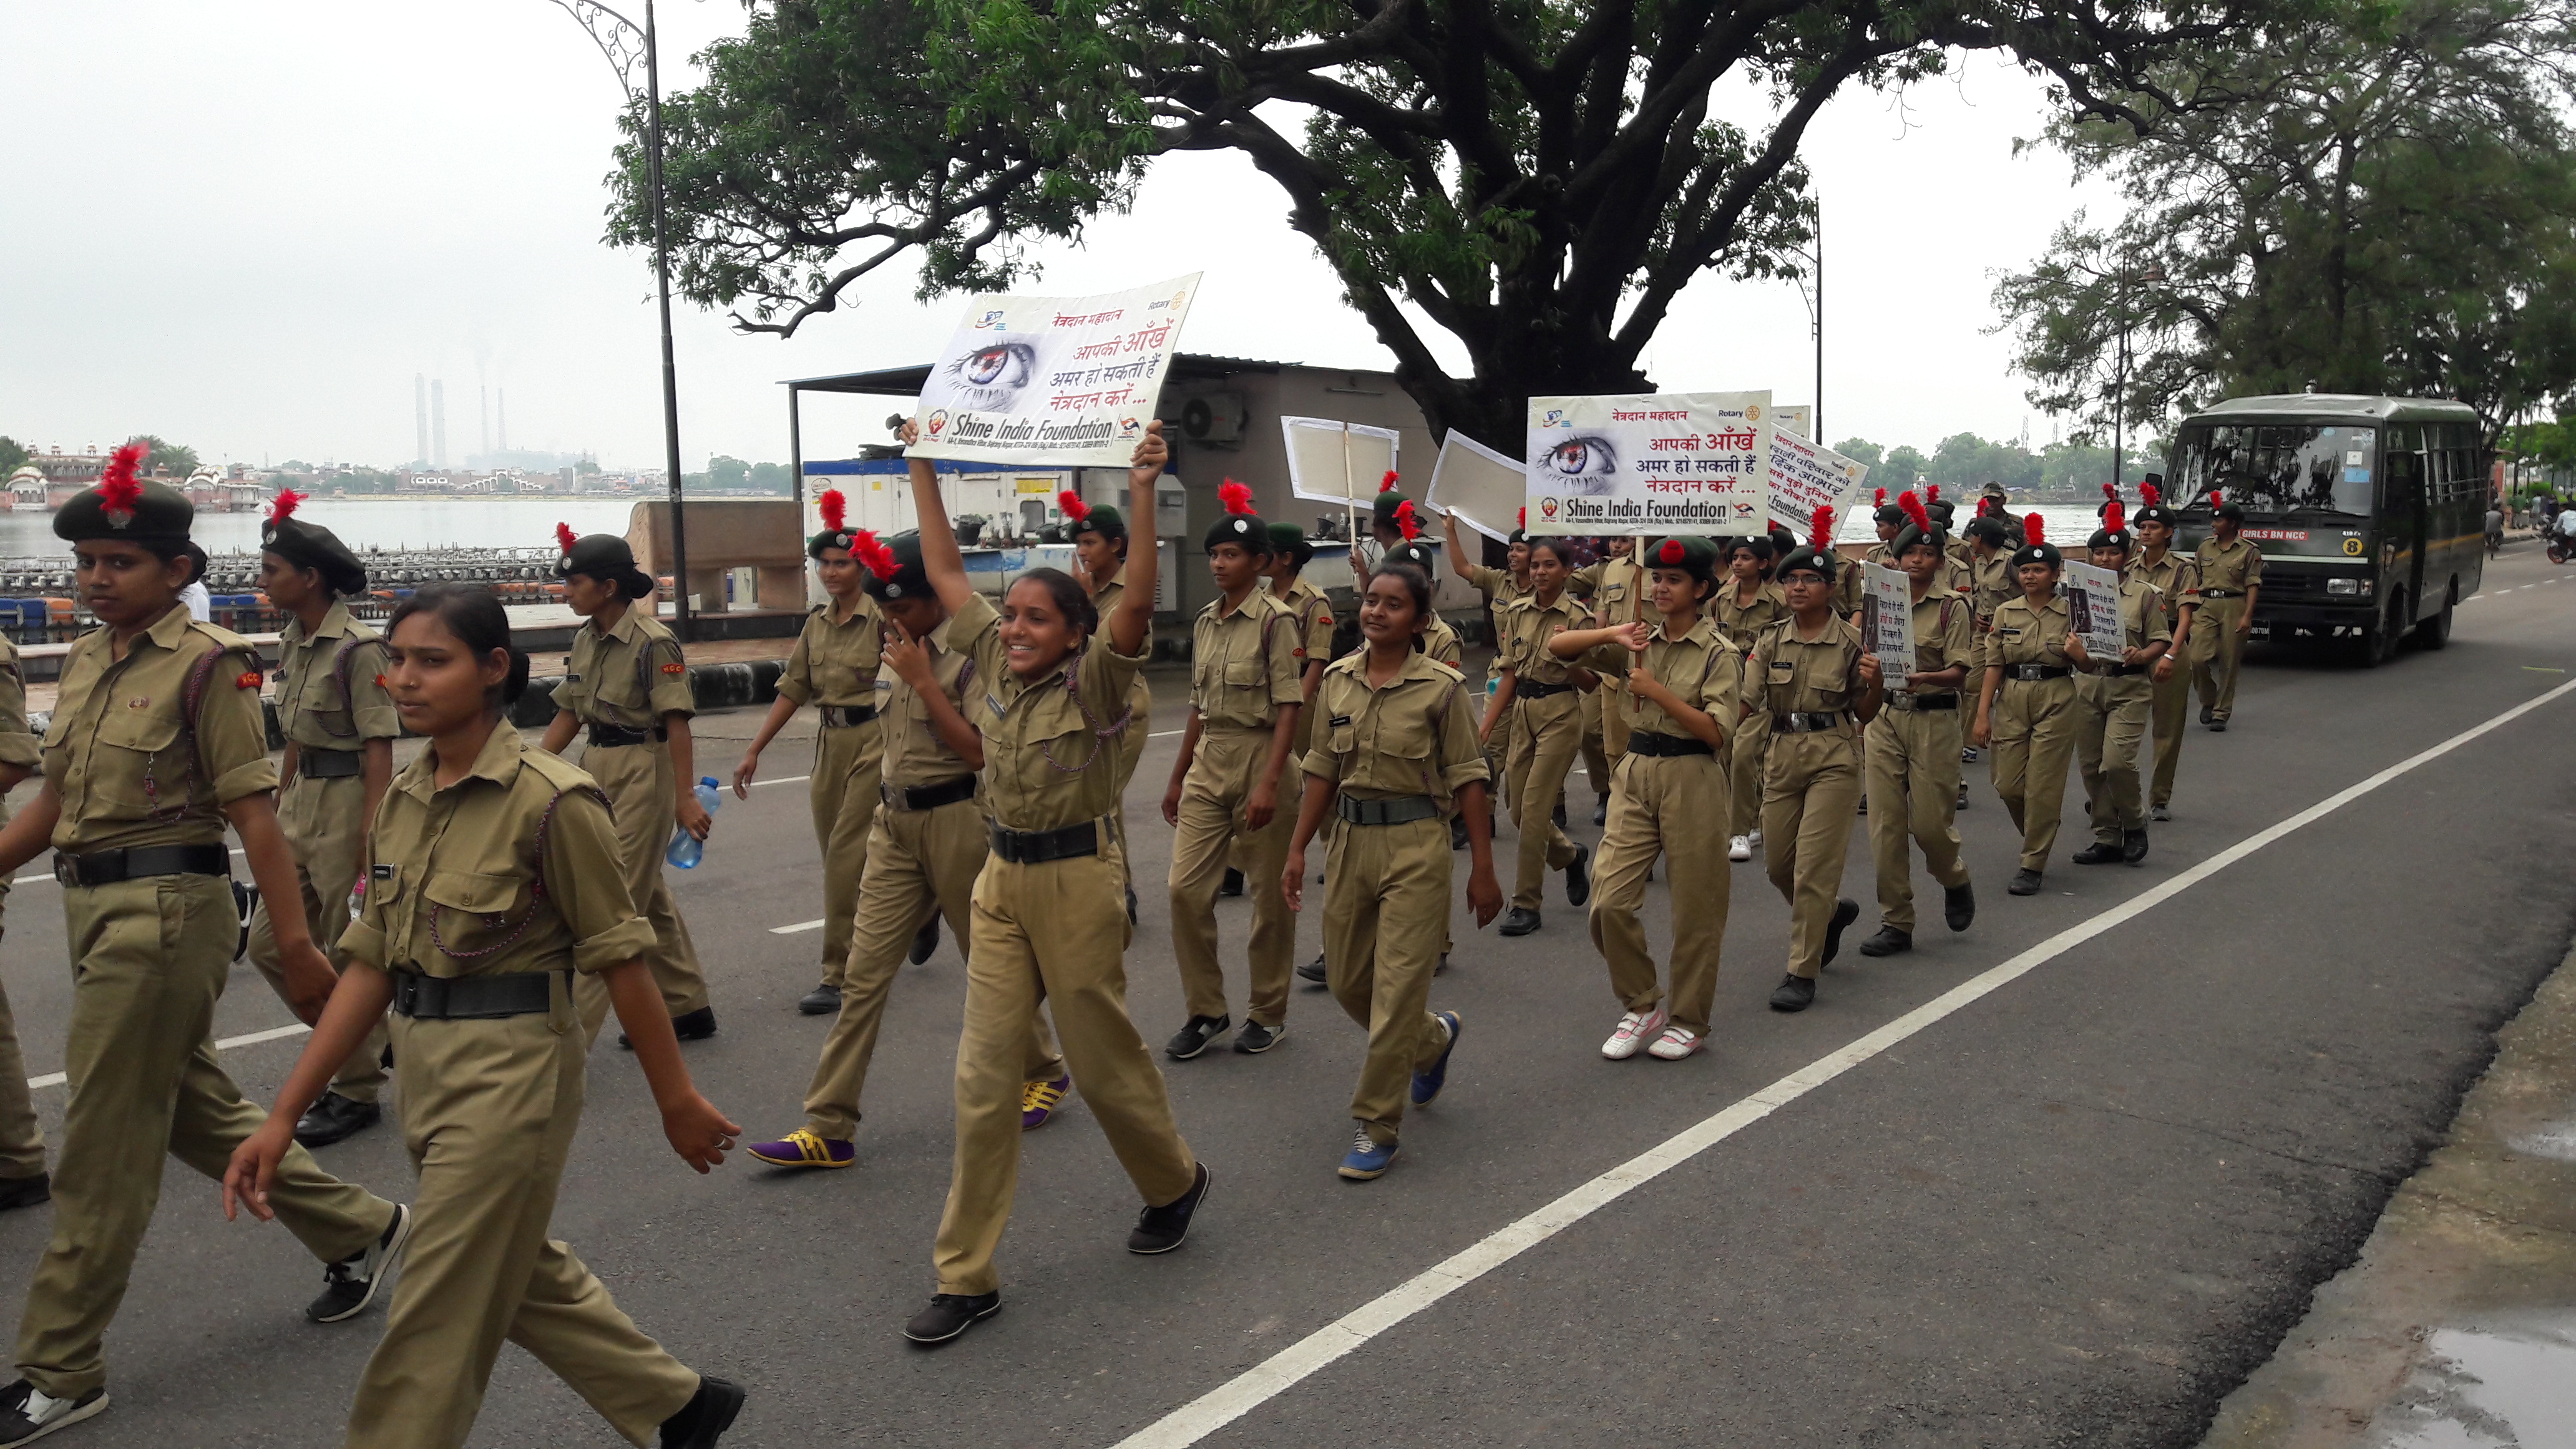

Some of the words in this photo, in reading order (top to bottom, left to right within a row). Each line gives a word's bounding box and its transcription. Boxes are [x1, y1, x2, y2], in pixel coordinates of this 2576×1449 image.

[1148, 300, 1170, 310] Rotary
[1052, 312, 1088, 328] नेत्रदान
[1088, 309, 1125, 325] महादान
[1073, 335, 1122, 359] आपकी
[1123, 318, 1174, 353] आँखें
[1050, 371, 1085, 387] अमर
[1085, 363, 1103, 387] हो
[1103, 356, 1146, 383] सकती
[1146, 353, 1161, 379] हैं
[1050, 390, 1103, 412] नेत्रदान
[1612, 408, 1646, 422] नेत्रदान
[1649, 411, 1688, 422] महादान
[1719, 409, 1743, 418] Rotary
[952, 413, 993, 438] Shine
[995, 417, 1034, 440] India
[1034, 416, 1113, 441] Foundation
[1649, 434, 1701, 451] आपकी
[1705, 426, 1757, 451] आँखें
[1792, 442, 1815, 458] महादान
[1636, 460, 1671, 474] अमर
[1674, 455, 1691, 474] हो
[1694, 455, 1740, 474] सकती
[1744, 454, 1757, 475] हैं
[1644, 475, 1703, 495] नेत्रदान
[1769, 468, 1785, 481] ससे
[1805, 485, 1833, 503] दुनिया
[1798, 471, 1843, 495] आभार
[1567, 497, 1603, 517] Shine
[1609, 497, 1641, 517] India
[1647, 497, 1726, 517] Foundation
[2242, 530, 2268, 539] GIRLS
[2270, 531, 2283, 539] BN
[2347, 540, 2358, 553] 8
